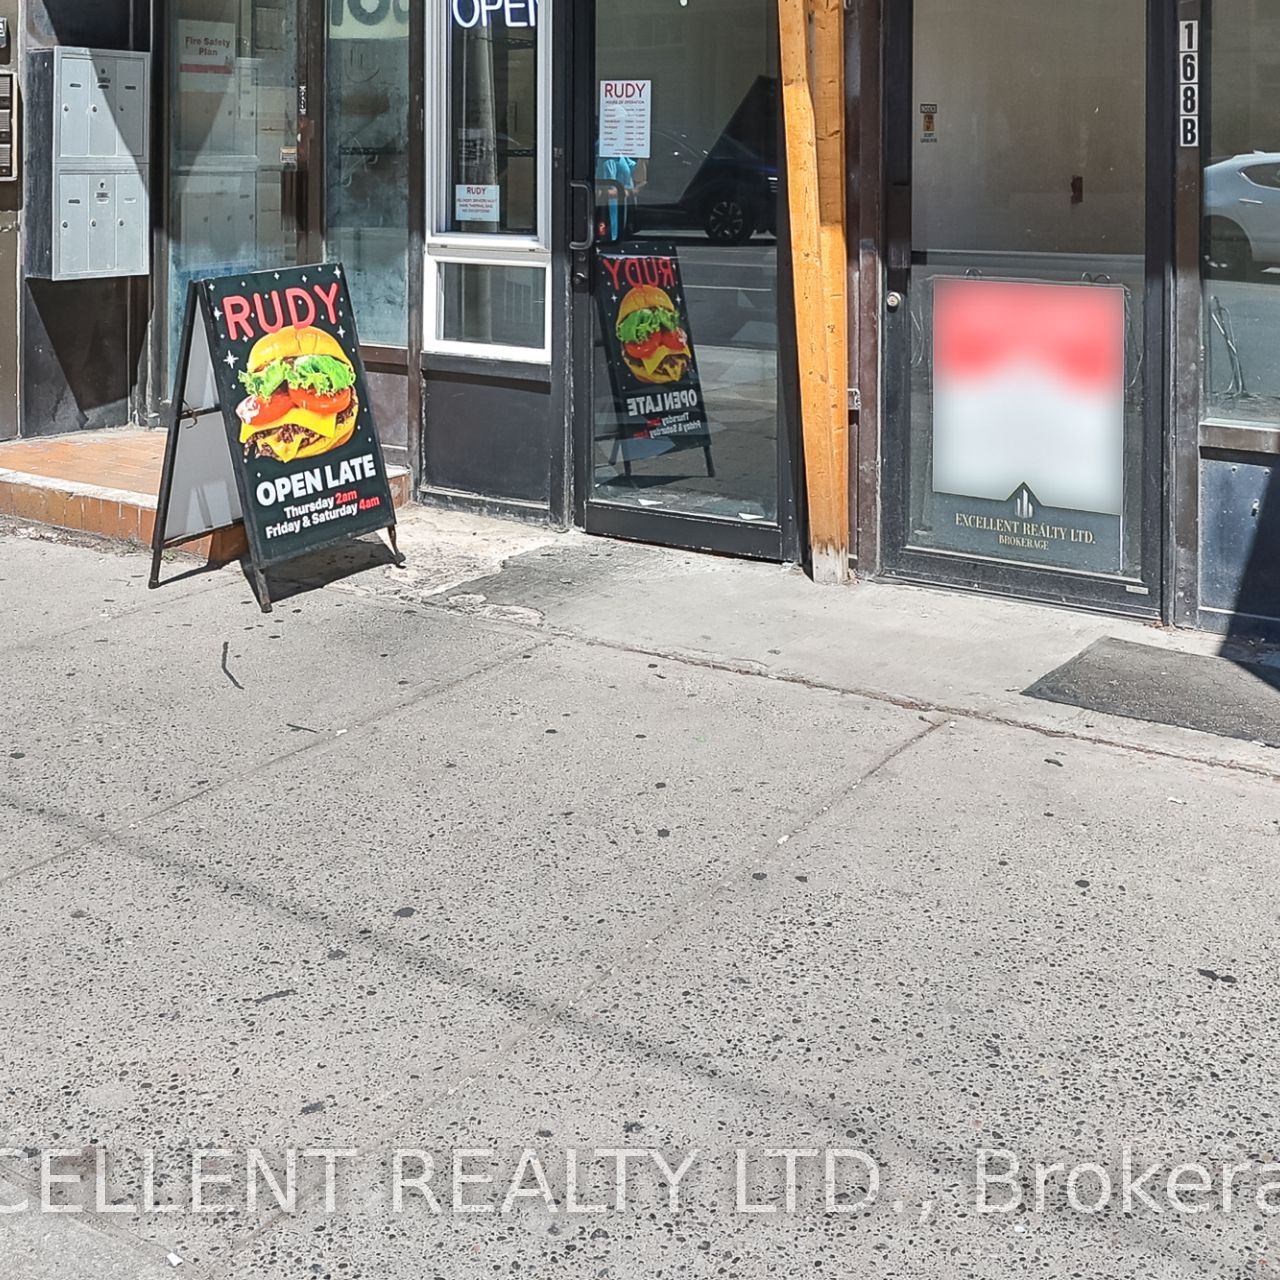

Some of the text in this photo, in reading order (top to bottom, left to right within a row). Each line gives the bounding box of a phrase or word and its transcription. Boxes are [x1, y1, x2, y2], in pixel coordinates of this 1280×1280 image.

[185, 36, 231, 49] Fire Safety
[198, 48, 218, 56] Plan
[604, 83, 646, 99] RUDY
[1181, 22, 1197, 146] 168B
[466, 186, 487, 195] RUDY
[222, 282, 339, 341] RUDY
[255, 454, 377, 507] OPEN LATE
[266, 496, 381, 540] Friday & Saturday 4am
[284, 489, 358, 520] Thursday 2am
[955, 512, 1097, 545] EXCELLENT REALTY LTD.
[998, 533, 1050, 551] BROKERAGE
